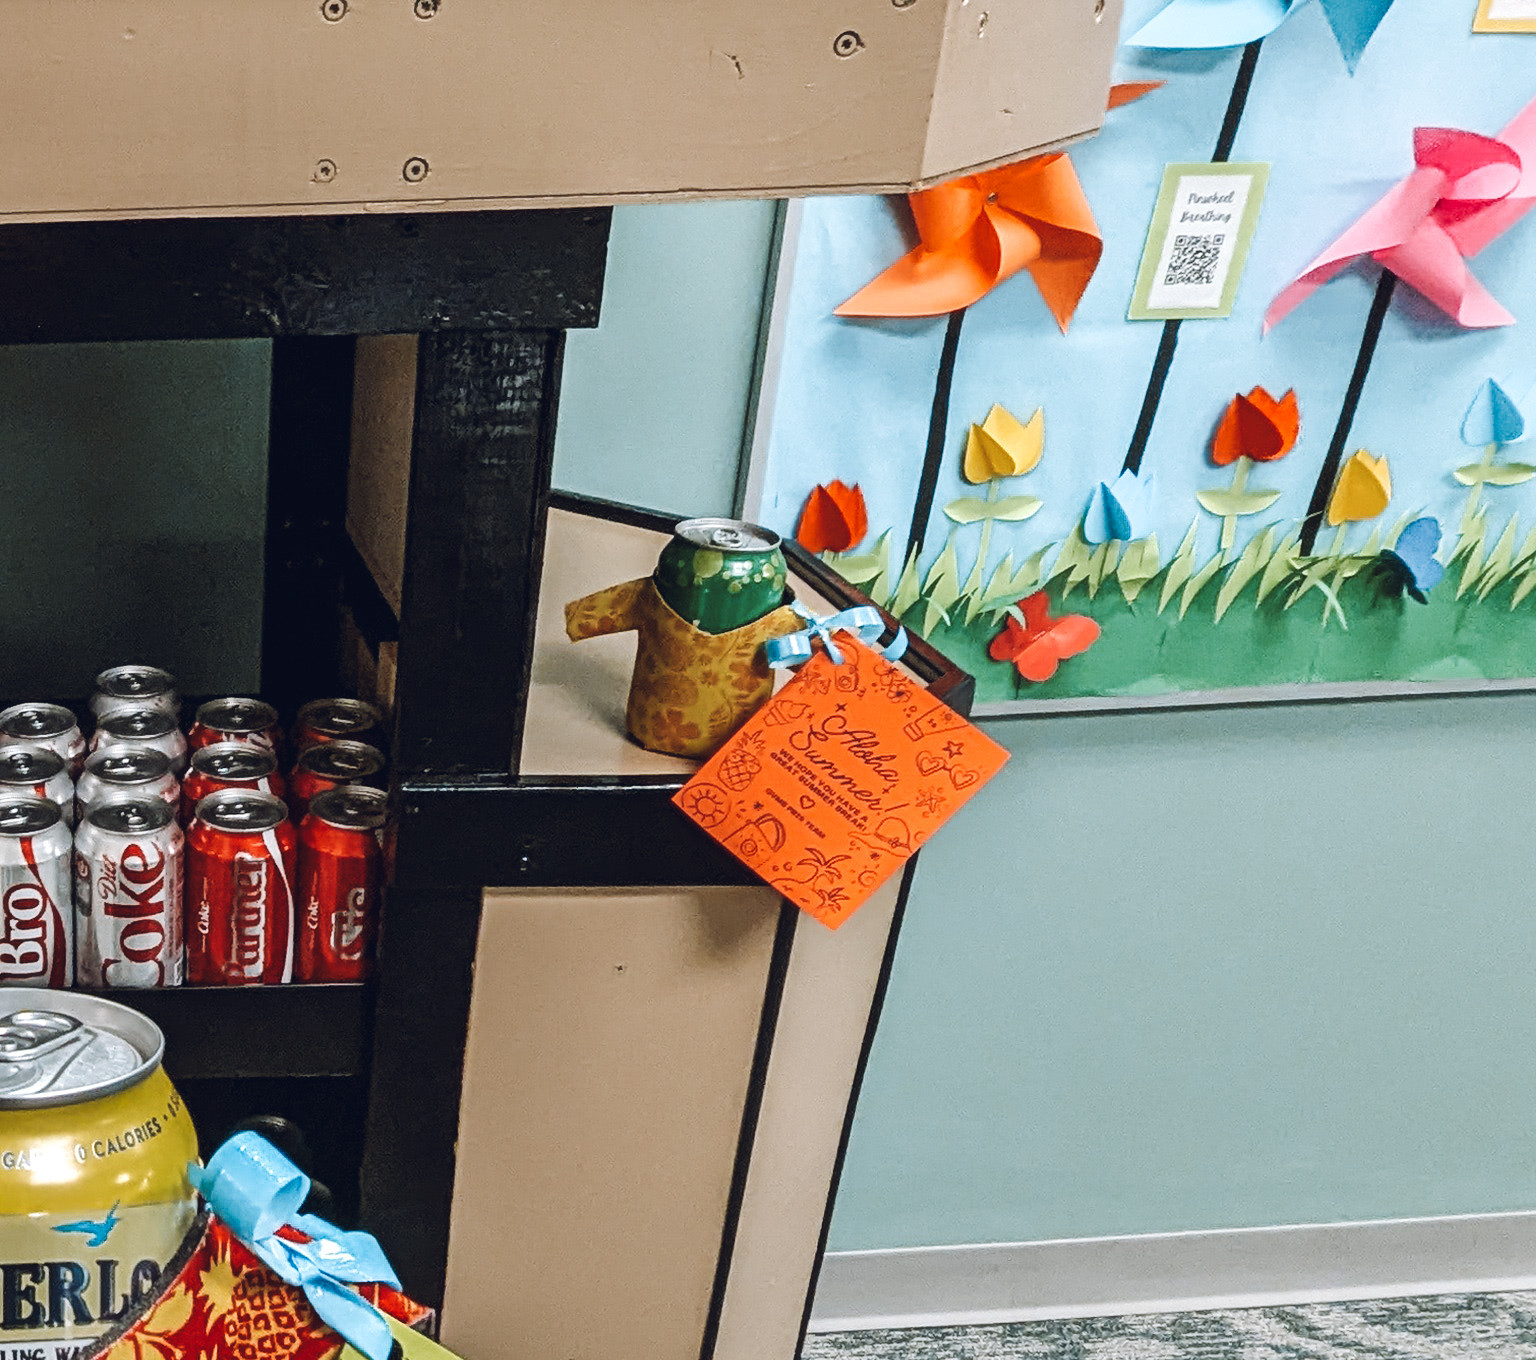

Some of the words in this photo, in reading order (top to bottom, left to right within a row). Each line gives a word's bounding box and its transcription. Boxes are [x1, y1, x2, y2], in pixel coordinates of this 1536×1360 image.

[1180, 210, 1232, 224] Breathing
[770, 752, 799, 776] GREAT
[798, 776, 835, 807] SUMMER
[779, 749, 795, 762] WE
[794, 761, 817, 781] HOPE
[818, 779, 836, 796] YOU
[836, 795, 861, 816] HAVE
[789, 724, 910, 816] Summer!
[806, 821, 826, 839] TEAM
[97, 854, 116, 899] Diet
[104, 843, 164, 987] Coke
[93, 1117, 162, 1159] CALORIES
